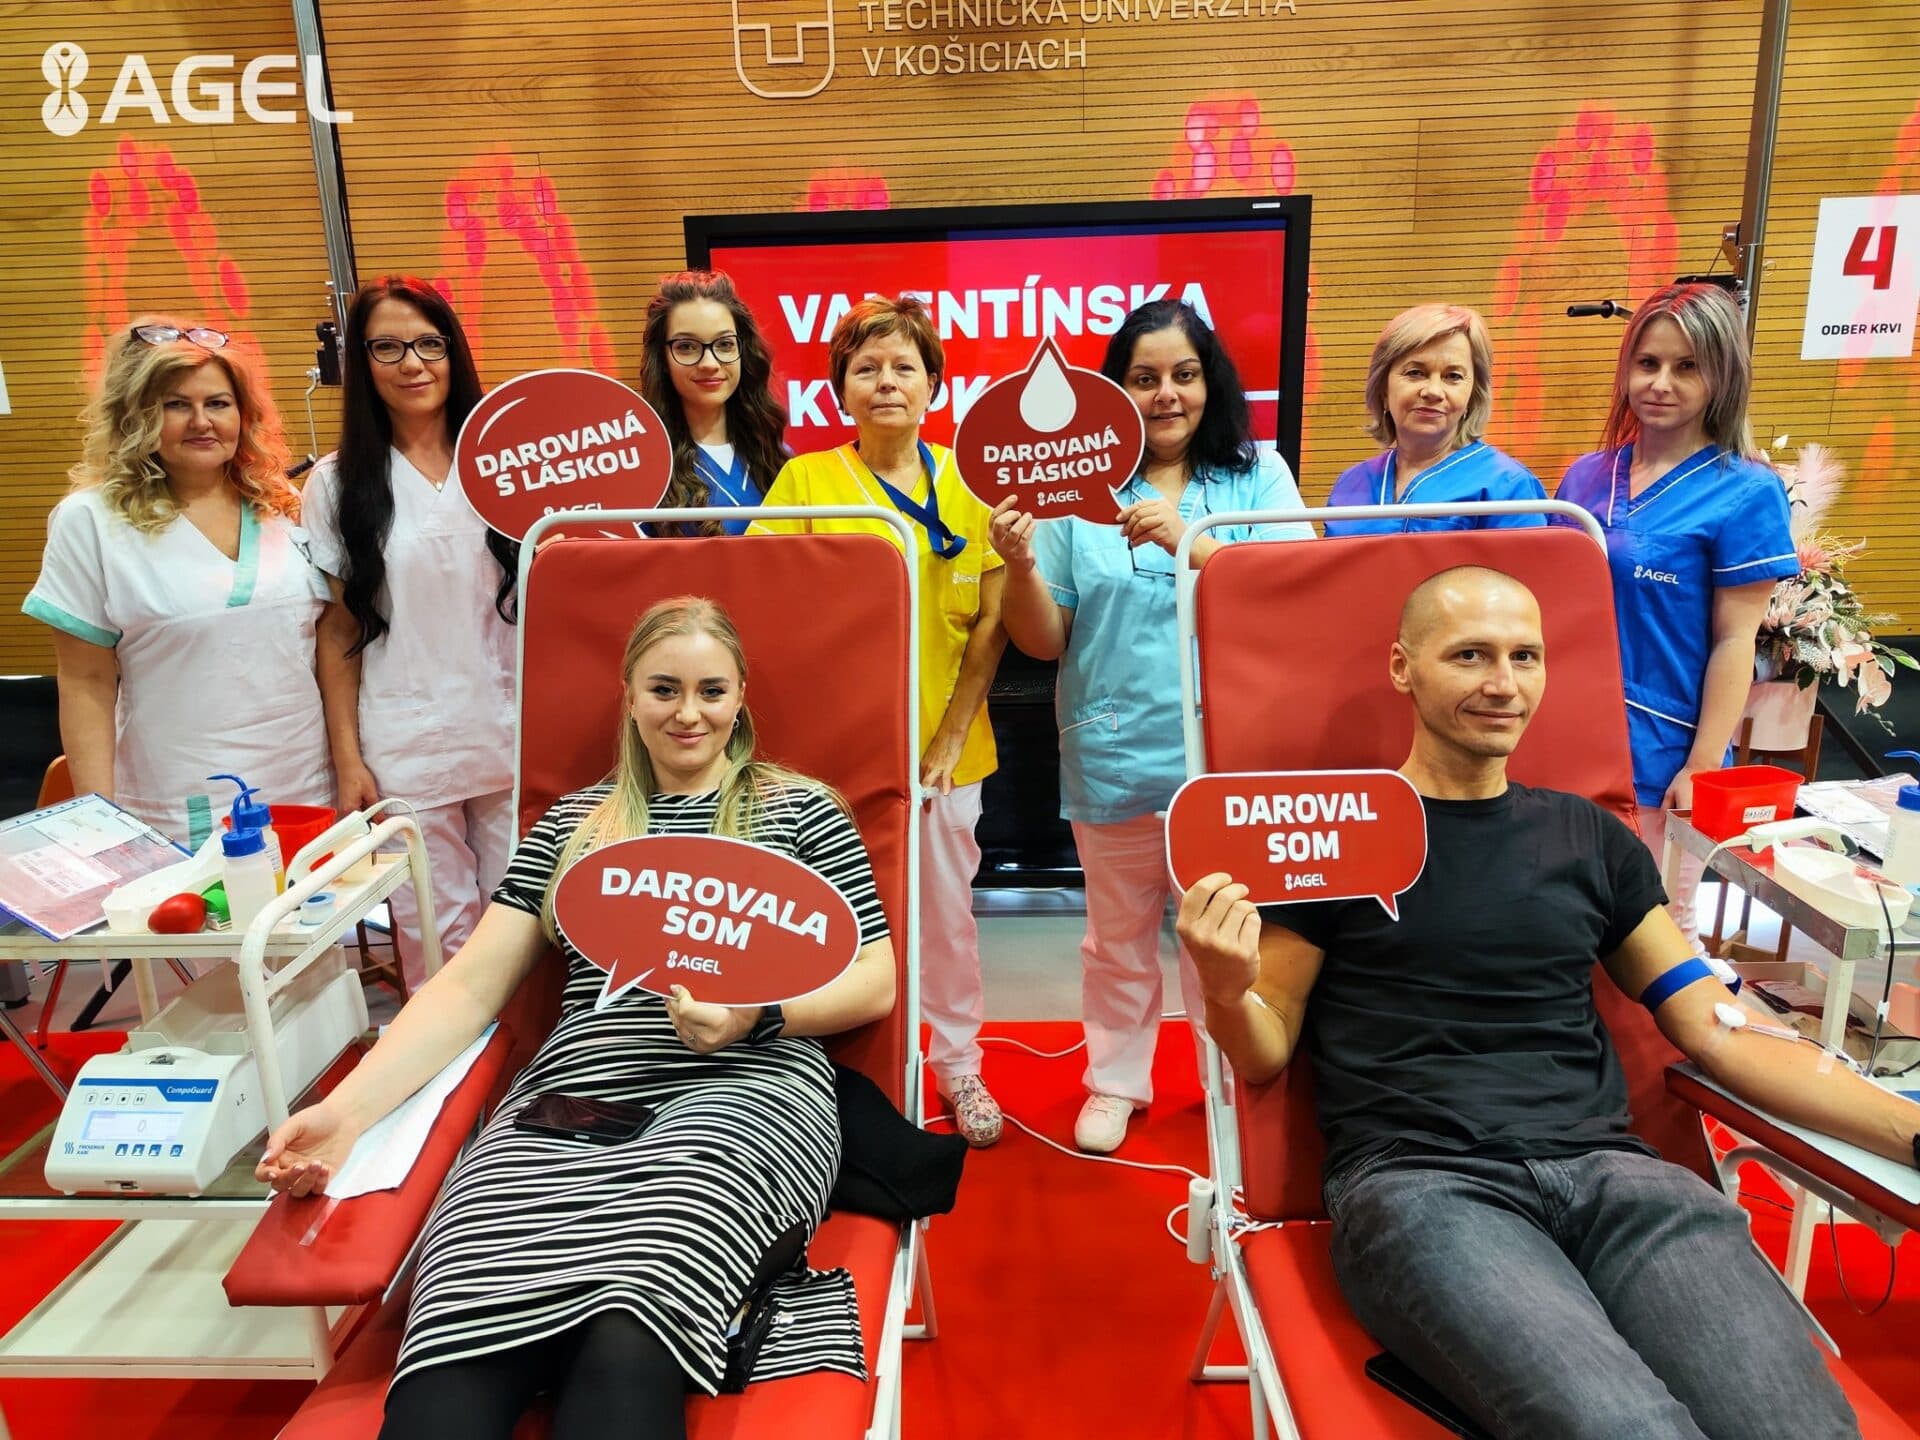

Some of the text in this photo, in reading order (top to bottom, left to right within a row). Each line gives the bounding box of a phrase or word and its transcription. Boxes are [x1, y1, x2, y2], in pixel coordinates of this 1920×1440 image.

[861, 36, 1087, 77] V KOŠICIACH
[1842, 226, 1898, 290] 4
[1821, 323, 1902, 336] ODBER KRVI
[475, 409, 647, 478] DAROVANÁ
[983, 425, 1121, 463] DAROVANÁ
[495, 446, 641, 497] S LÁSKOU
[996, 453, 1112, 485] S LÁSKOU
[1046, 490, 1084, 505] AGEL
[1642, 568, 1680, 585] AGEL
[1225, 792, 1378, 826] DAROVAL
[1267, 830, 1340, 863] SOM
[1293, 873, 1327, 888] AGEL
[601, 867, 829, 946] DAROVALA
[662, 905, 753, 951] SOM
[677, 954, 722, 976] AGEL
[166, 1086, 214, 1096] CompoGuard
